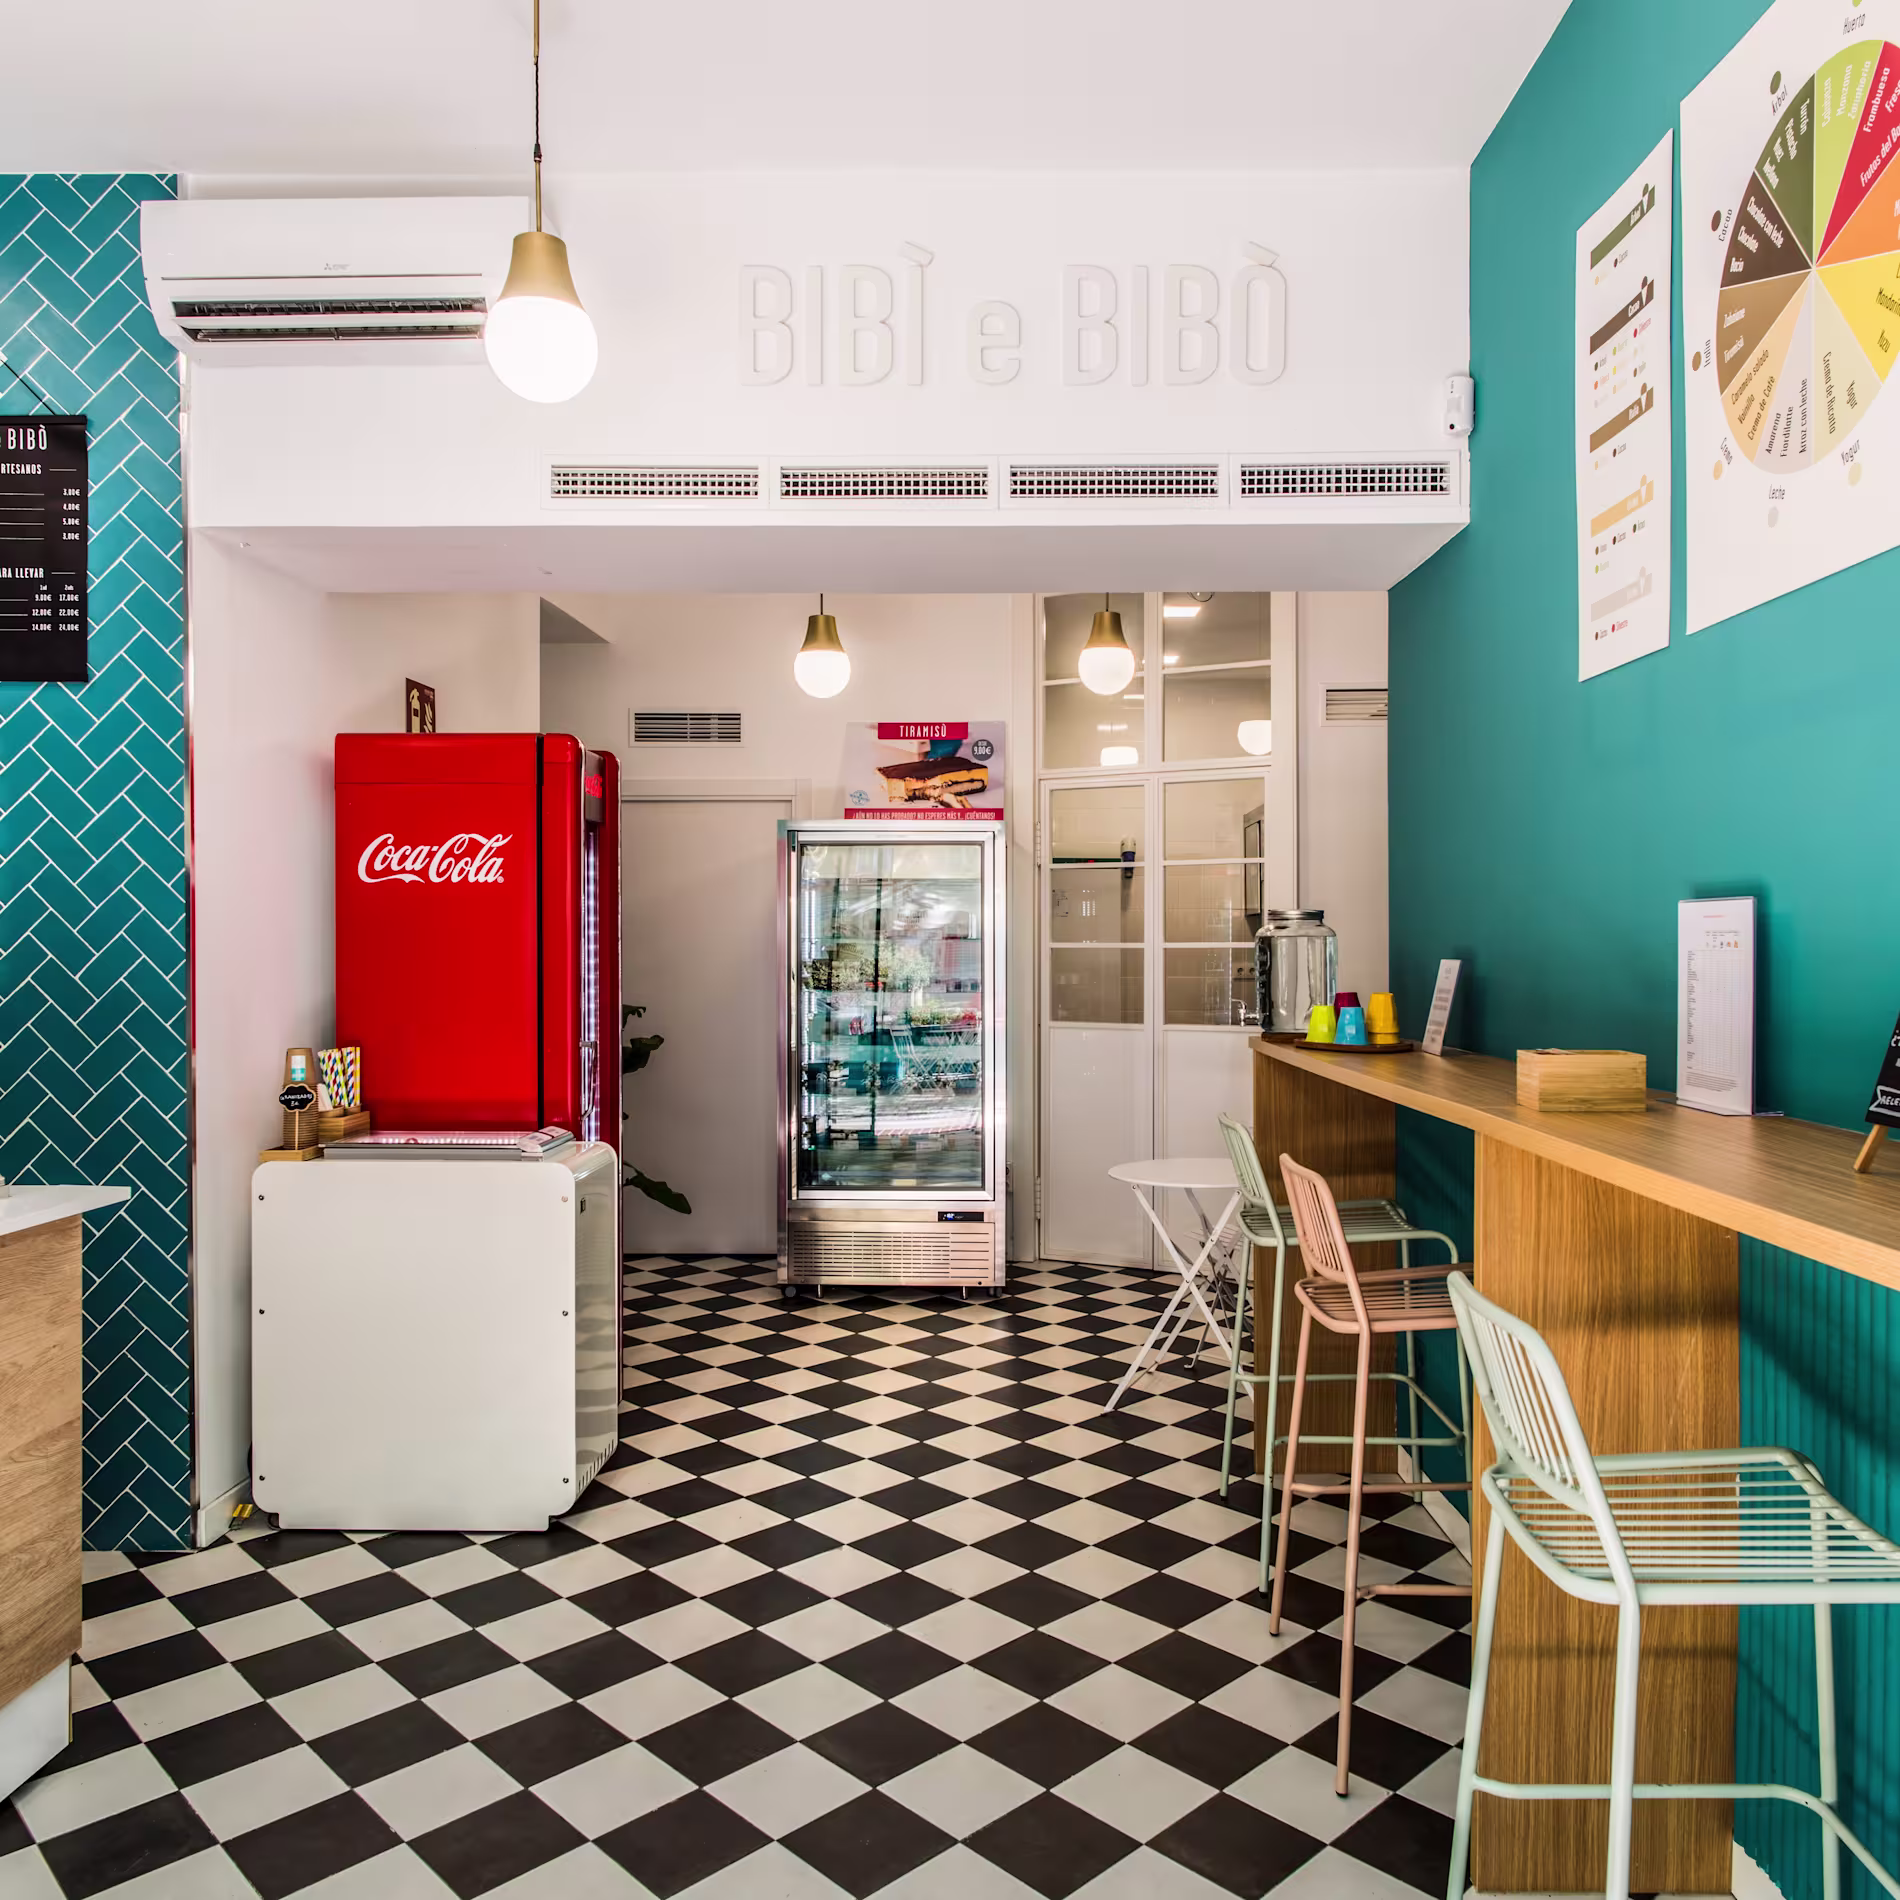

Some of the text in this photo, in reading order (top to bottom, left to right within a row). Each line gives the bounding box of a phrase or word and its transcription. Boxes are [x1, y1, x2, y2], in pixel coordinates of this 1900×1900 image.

[1835, 64, 1853, 117] Manzana
[1863, 67, 1891, 132] Frambuesa
[1860, 154, 1881, 188] Frutos
[1880, 134, 1893, 159] del
[1718, 208, 1733, 242] Cacao
[738, 240, 1288, 387] BIBÌ e BIBÒ
[1822, 351, 1833, 385] Crema
[1825, 384, 1835, 399] de
[7, 424, 48, 450] BIBÒ
[1747, 411, 1762, 441] Crema
[1758, 398, 1767, 412] de
[1765, 412, 1782, 454] Amarena
[1840, 438, 1860, 466] Yogur
[15, 567, 44, 579] LLEVAR
[358, 833, 513, 884] Coca-Cola
